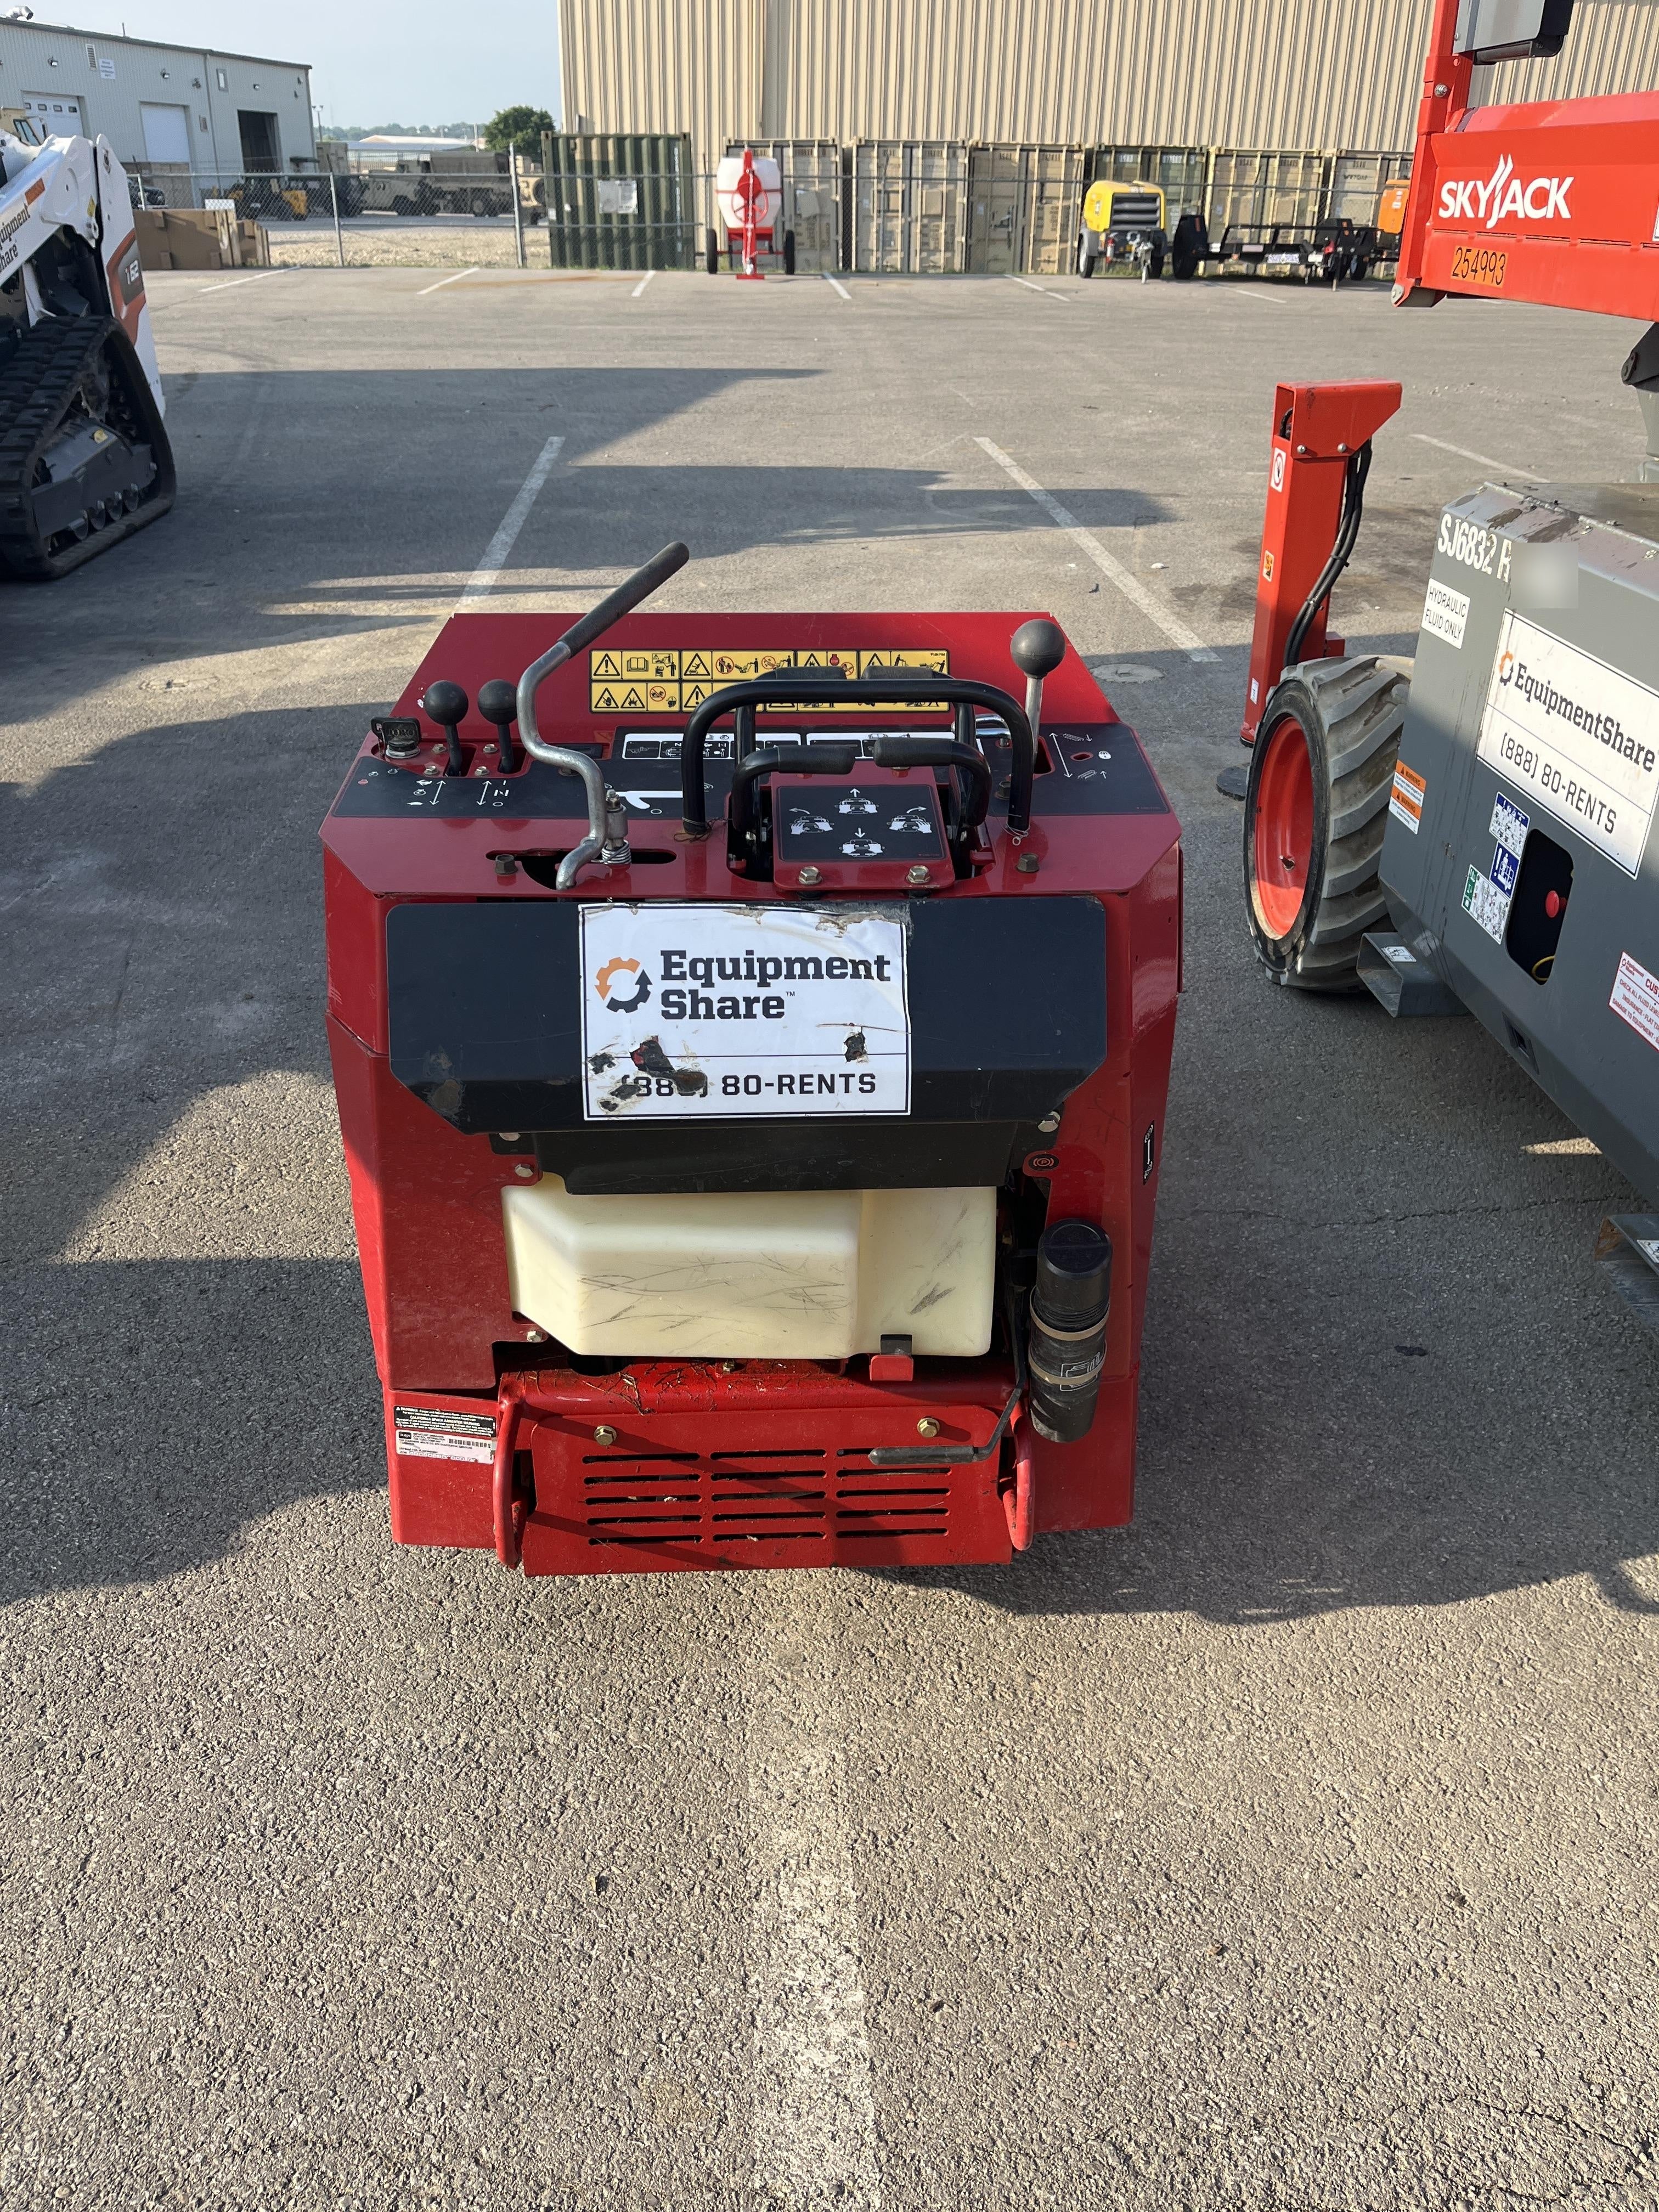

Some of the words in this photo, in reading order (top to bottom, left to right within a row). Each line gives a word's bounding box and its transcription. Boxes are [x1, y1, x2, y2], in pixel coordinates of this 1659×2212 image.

[1438, 153, 1574, 229] SKYJACK
[0, 202, 31, 250] uipment
[0, 244, 18, 273] hare
[1452, 247, 1506, 285] 254993
[1438, 513, 1498, 575] SJ6832
[1429, 585, 1466, 618] HYDRAULIC
[1425, 607, 1443, 629] FLUID
[1444, 619, 1463, 640] ONLY
[386, 728, 415, 738] TORO
[1515, 663, 1656, 772] EquipmentShare
[1500, 732, 1538, 779] (888)
[1542, 763, 1617, 834] 80-RENTS
[661, 950, 891, 988] Equipment
[661, 989, 785, 1020] Share
[722, 1073, 876, 1096] 80-RENTS
